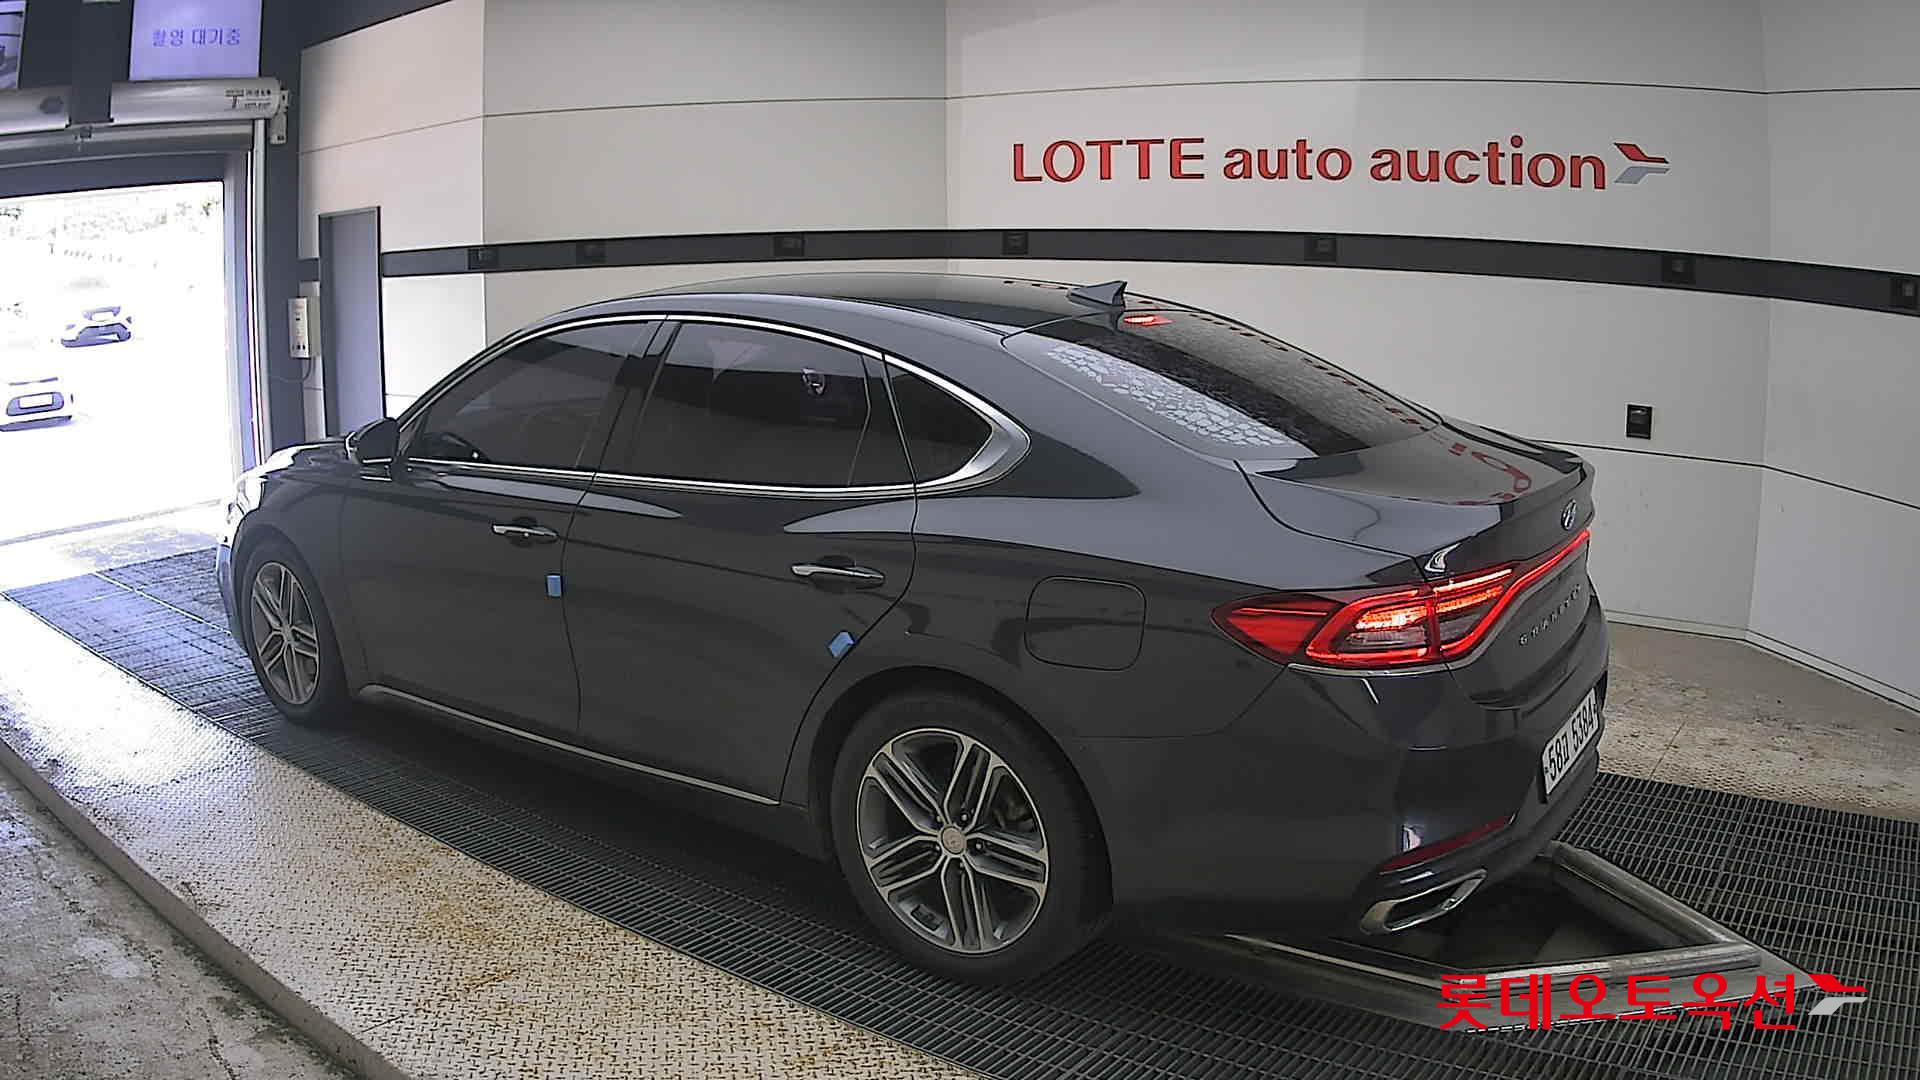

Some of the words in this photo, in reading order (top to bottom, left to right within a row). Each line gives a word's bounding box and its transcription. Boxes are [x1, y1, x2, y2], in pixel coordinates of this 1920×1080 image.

[152, 27, 184, 47] 촬영
[191, 27, 241, 46] 대기중
[1013, 137, 1206, 183] LOTTE
[1224, 139, 1353, 181] auto
[1370, 135, 1606, 190] auction
[1571, 696, 1594, 753] 5384
